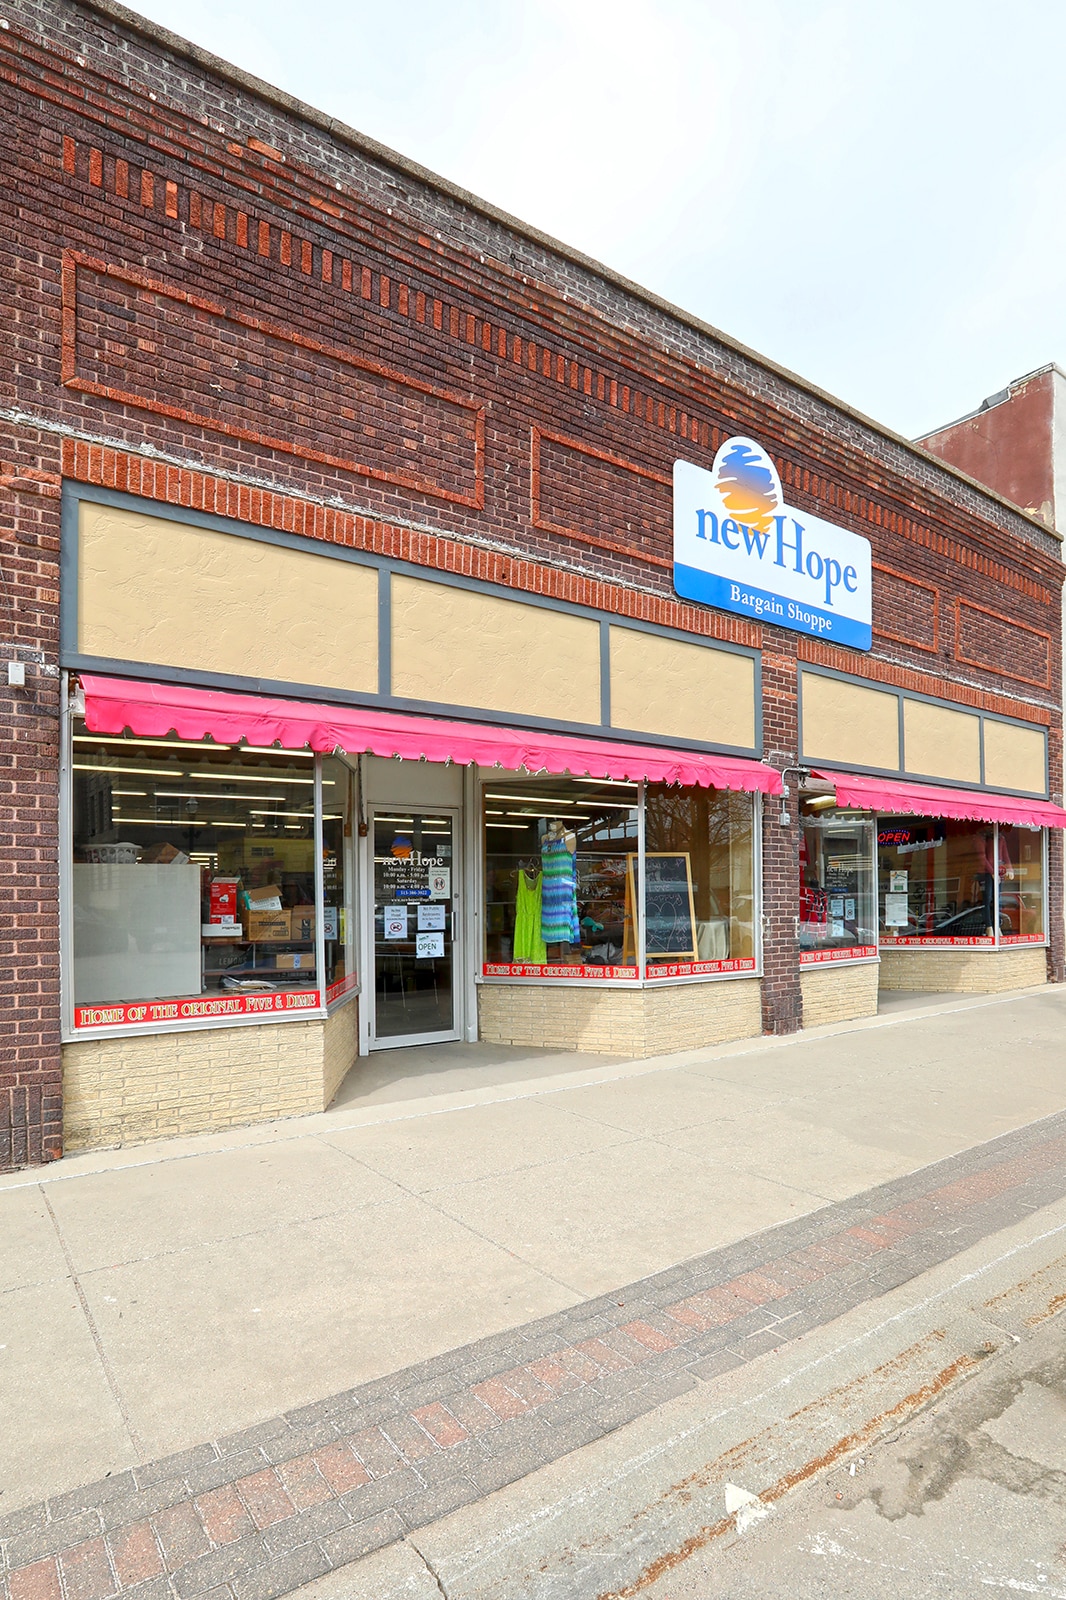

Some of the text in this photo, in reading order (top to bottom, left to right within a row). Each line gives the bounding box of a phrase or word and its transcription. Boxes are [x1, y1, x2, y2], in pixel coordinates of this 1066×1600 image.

[730, 584, 833, 633] Bargain Shoppe
[877, 832, 911, 843] OPEN
[418, 942, 437, 951] OPEN
[219, 957, 248, 965] LEMONS
[511, 965, 523, 975] OF
[524, 966, 541, 976] THE
[542, 966, 583, 977] ORIGINAL
[584, 967, 603, 977] FIVE
[605, 968, 611, 977] &
[668, 965, 677, 975] OF
[679, 964, 691, 974] THE
[80, 994, 316, 1025] HOME OF THE ORIGINAL FIVE & DIME
